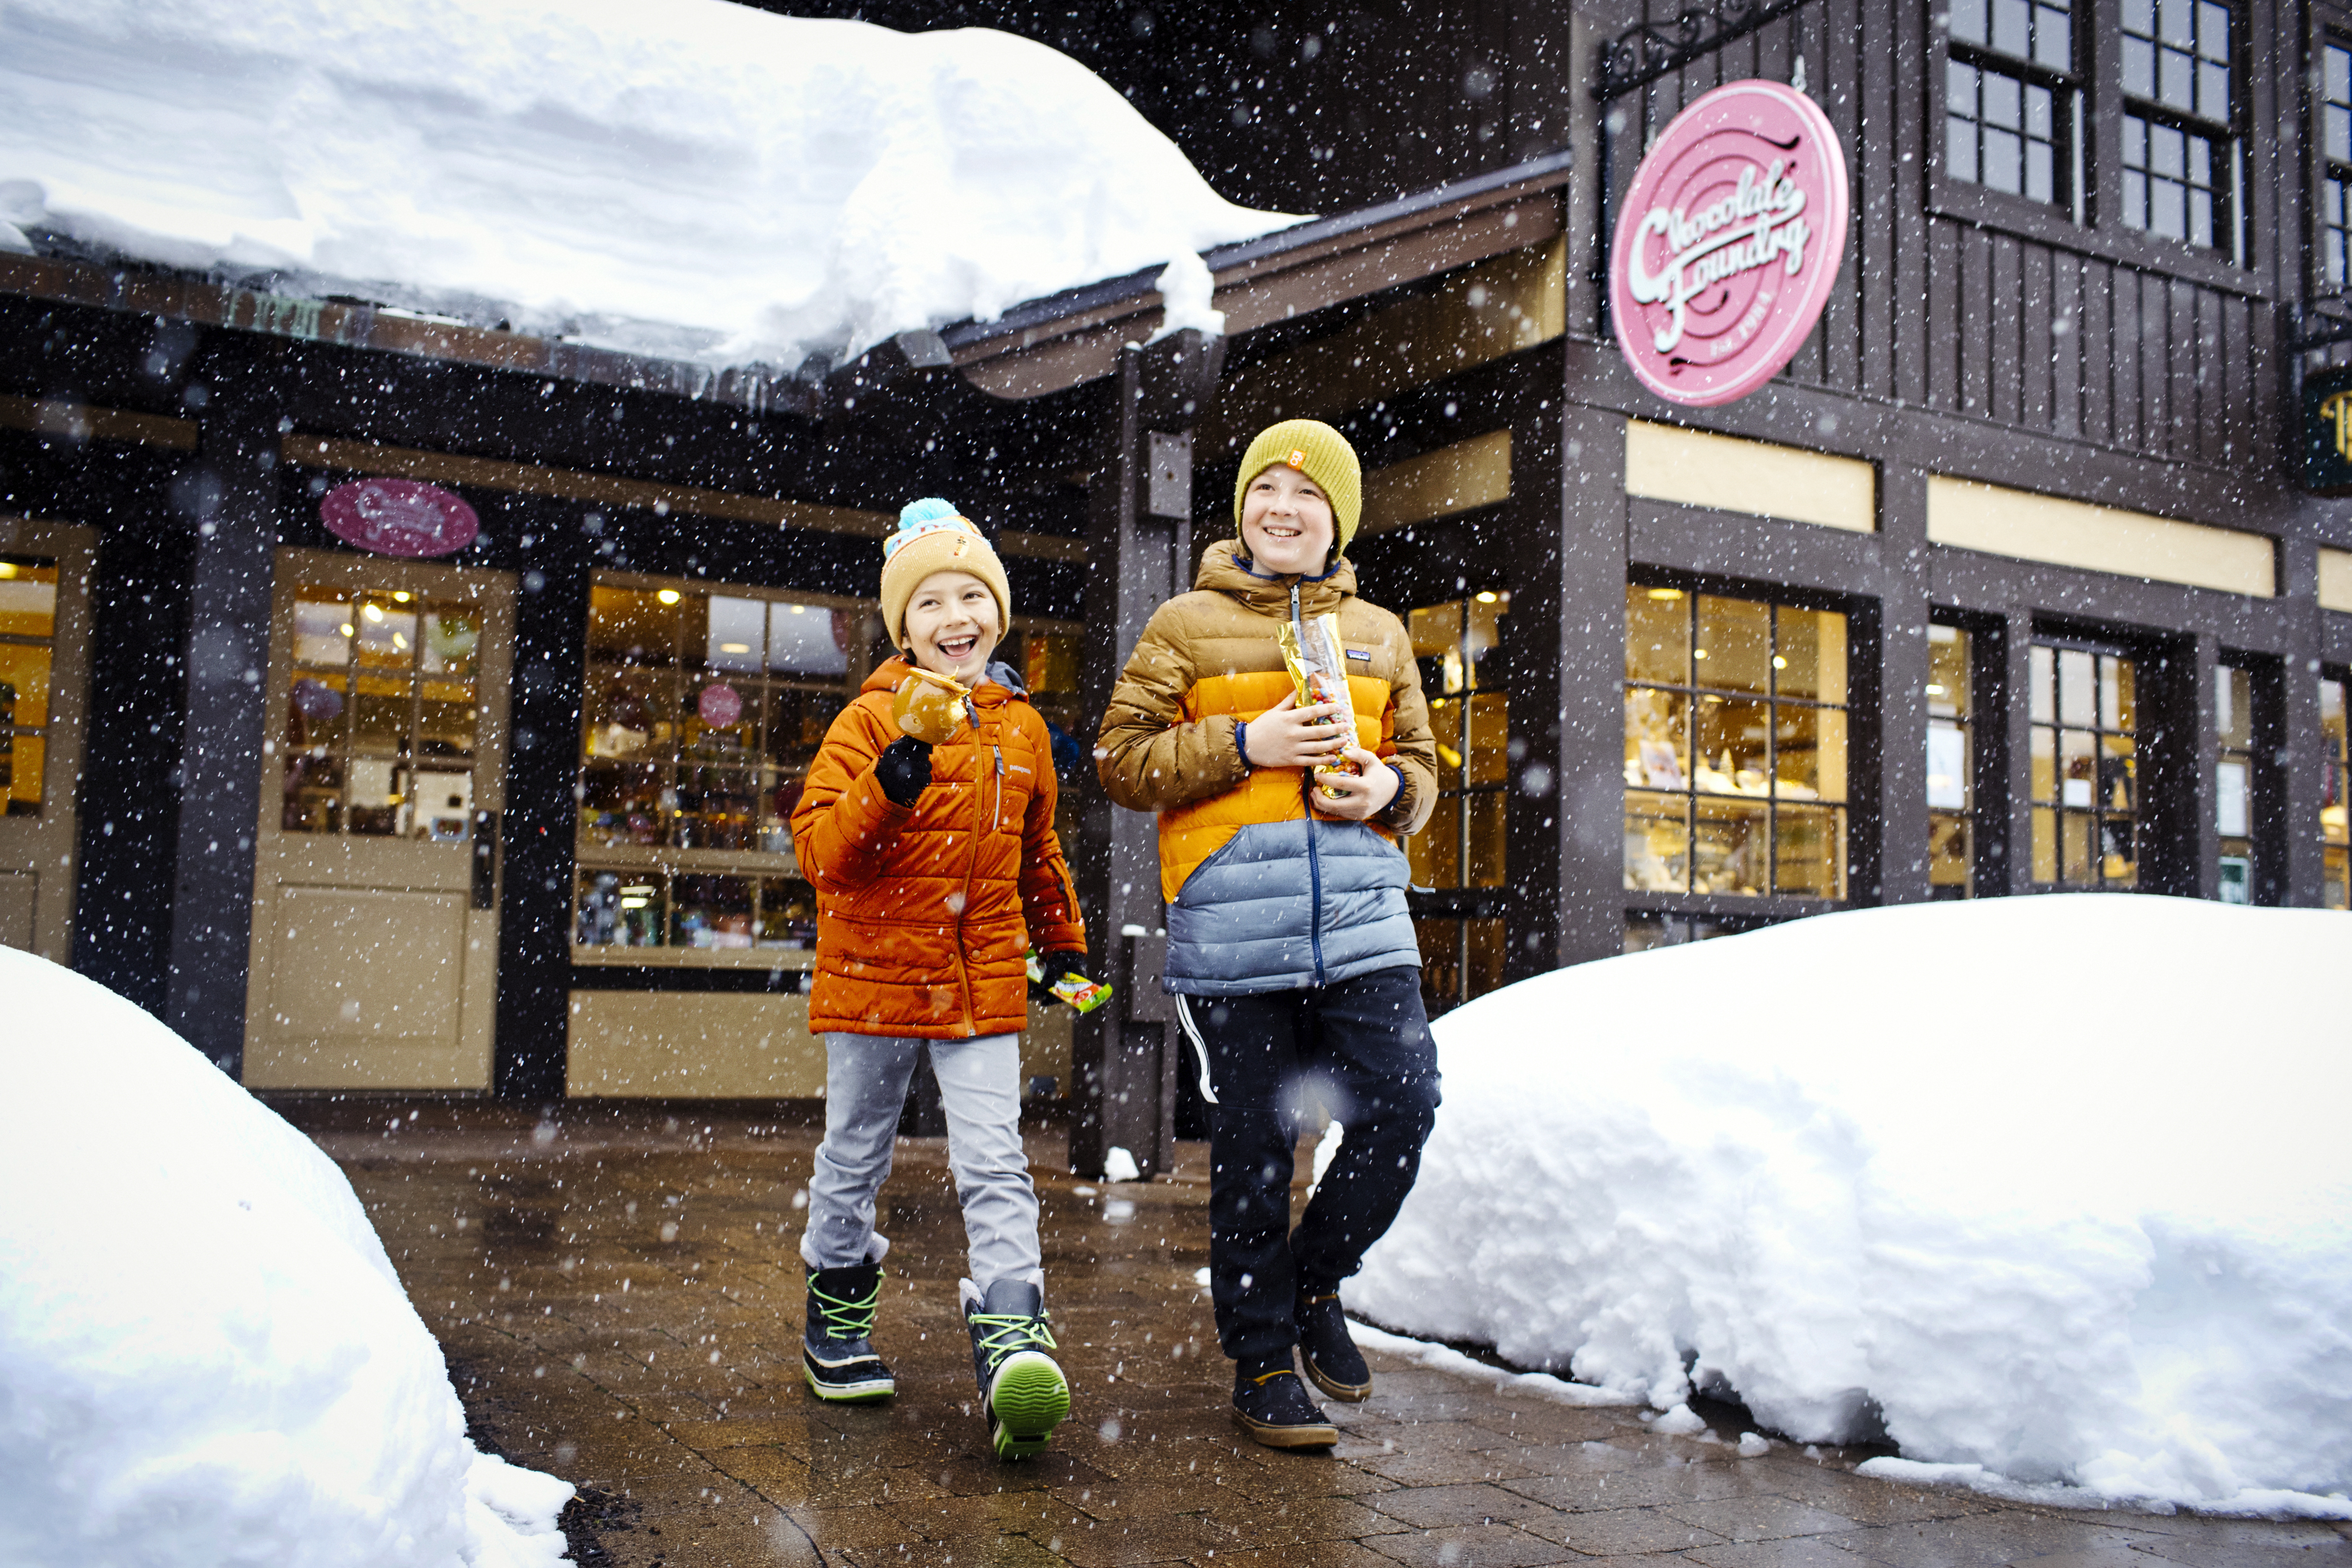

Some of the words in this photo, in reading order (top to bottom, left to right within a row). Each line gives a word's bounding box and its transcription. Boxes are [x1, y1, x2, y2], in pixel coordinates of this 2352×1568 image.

[1629, 159, 1805, 303] Chocolate
[1654, 212, 1811, 353] Foundry
[1009, 765, 1031, 775] patagonia
